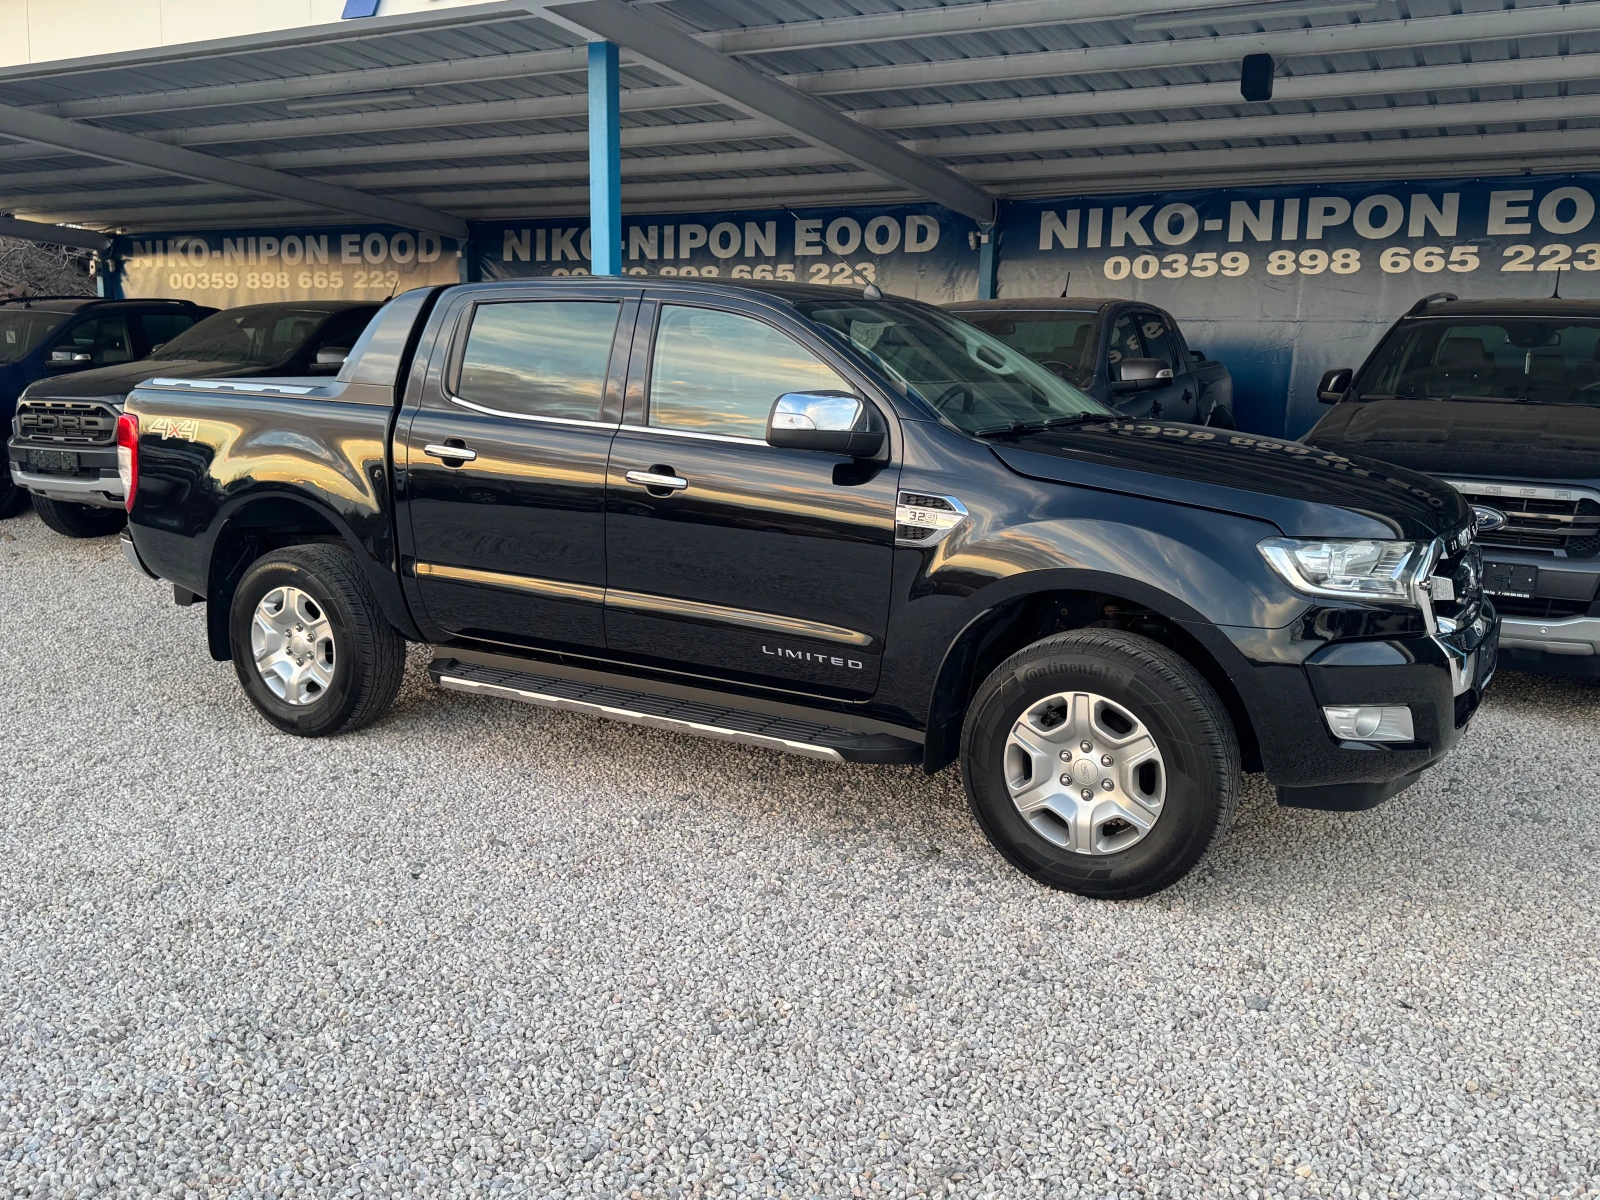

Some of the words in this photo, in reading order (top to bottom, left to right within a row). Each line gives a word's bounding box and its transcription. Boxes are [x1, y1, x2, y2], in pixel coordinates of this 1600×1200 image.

[1039, 193, 1460, 250] NIKO-NIPON
[1487, 186, 1600, 236] EO
[794, 215, 941, 256] EOOD
[132, 234, 329, 268] NIKO-NIPON
[341, 232, 442, 265] EOOD
[1103, 250, 1250, 281] 00359
[1267, 247, 1361, 275] 898
[1379, 245, 1480, 274] 665
[1500, 243, 1600, 272] 223
[168, 272, 239, 290] 00359
[246, 271, 291, 290] 898
[298, 270, 344, 289] 665
[353, 270, 400, 289] 223
[809, 262, 877, 285] 223
[20, 413, 104, 430] FORD
[762, 645, 863, 670] LIMITED
[1023, 661, 1111, 684] Continental
